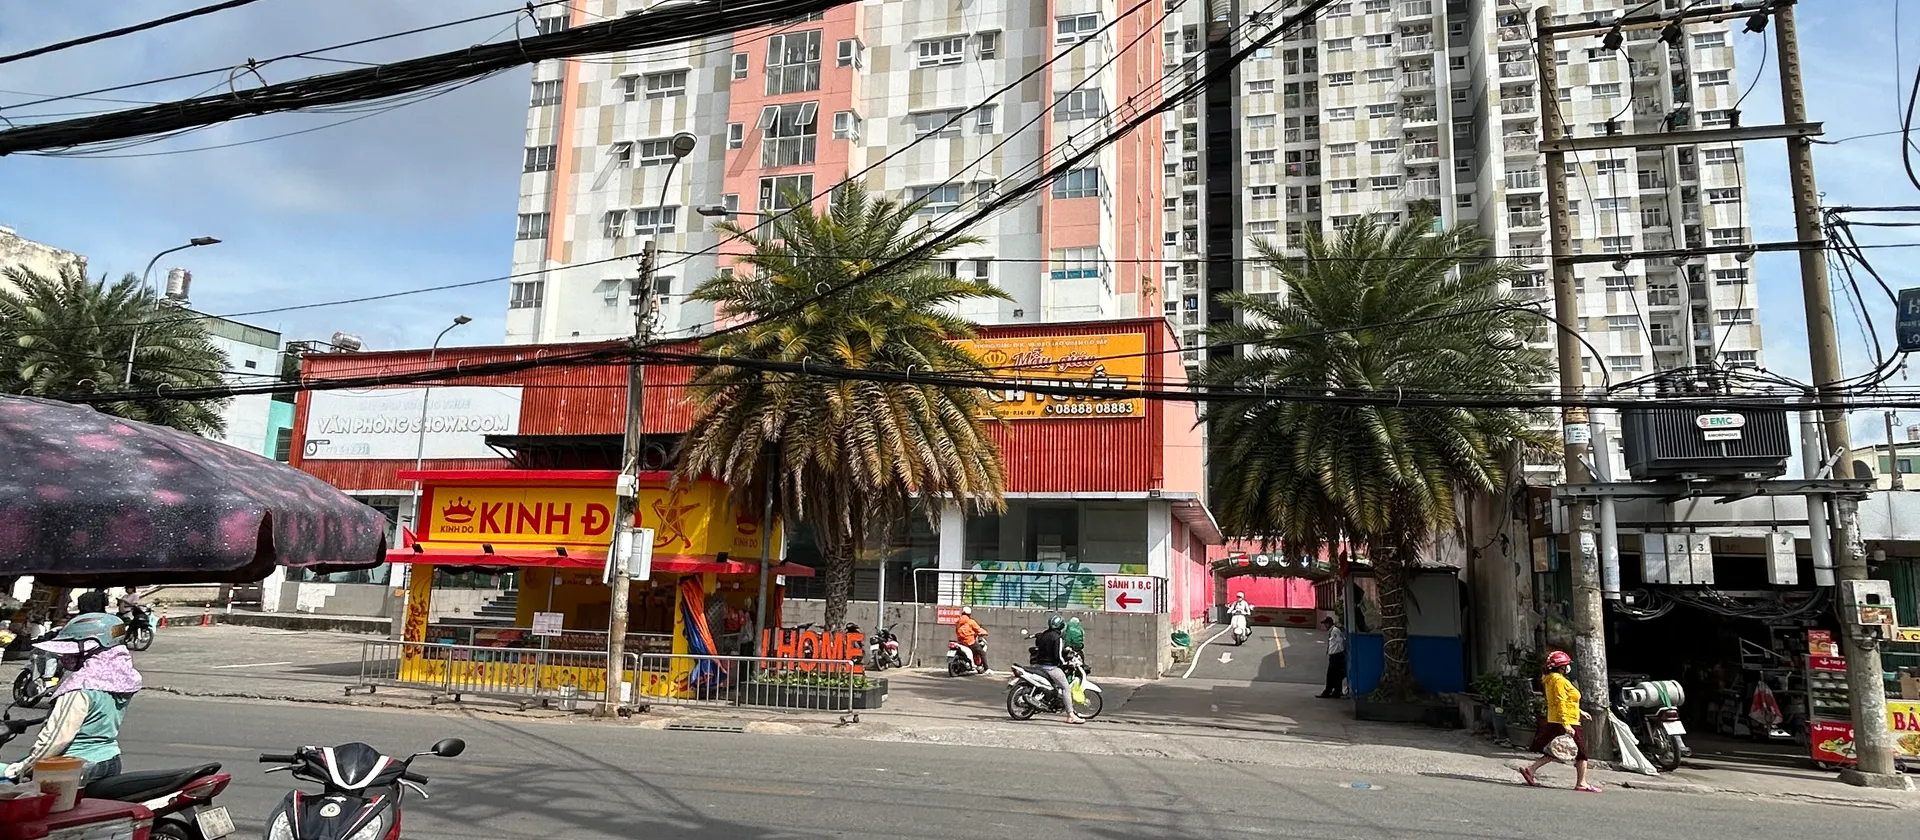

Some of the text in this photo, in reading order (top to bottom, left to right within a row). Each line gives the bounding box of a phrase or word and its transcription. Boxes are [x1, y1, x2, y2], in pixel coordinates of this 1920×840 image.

[1055, 402, 1134, 415] 08888 08883
[353, 413, 410, 434] PHÒNG
[411, 414, 510, 434] SHOWROOM
[1709, 417, 1733, 425] EMC
[479, 502, 572, 535] KINH
[440, 525, 474, 533] KINH DO
[1677, 544, 1684, 552] 2
[1697, 543, 1704, 552] 3
[1131, 581, 1136, 590] 1
[1138, 581, 1152, 590] B,C
[777, 629, 866, 675] HOME
